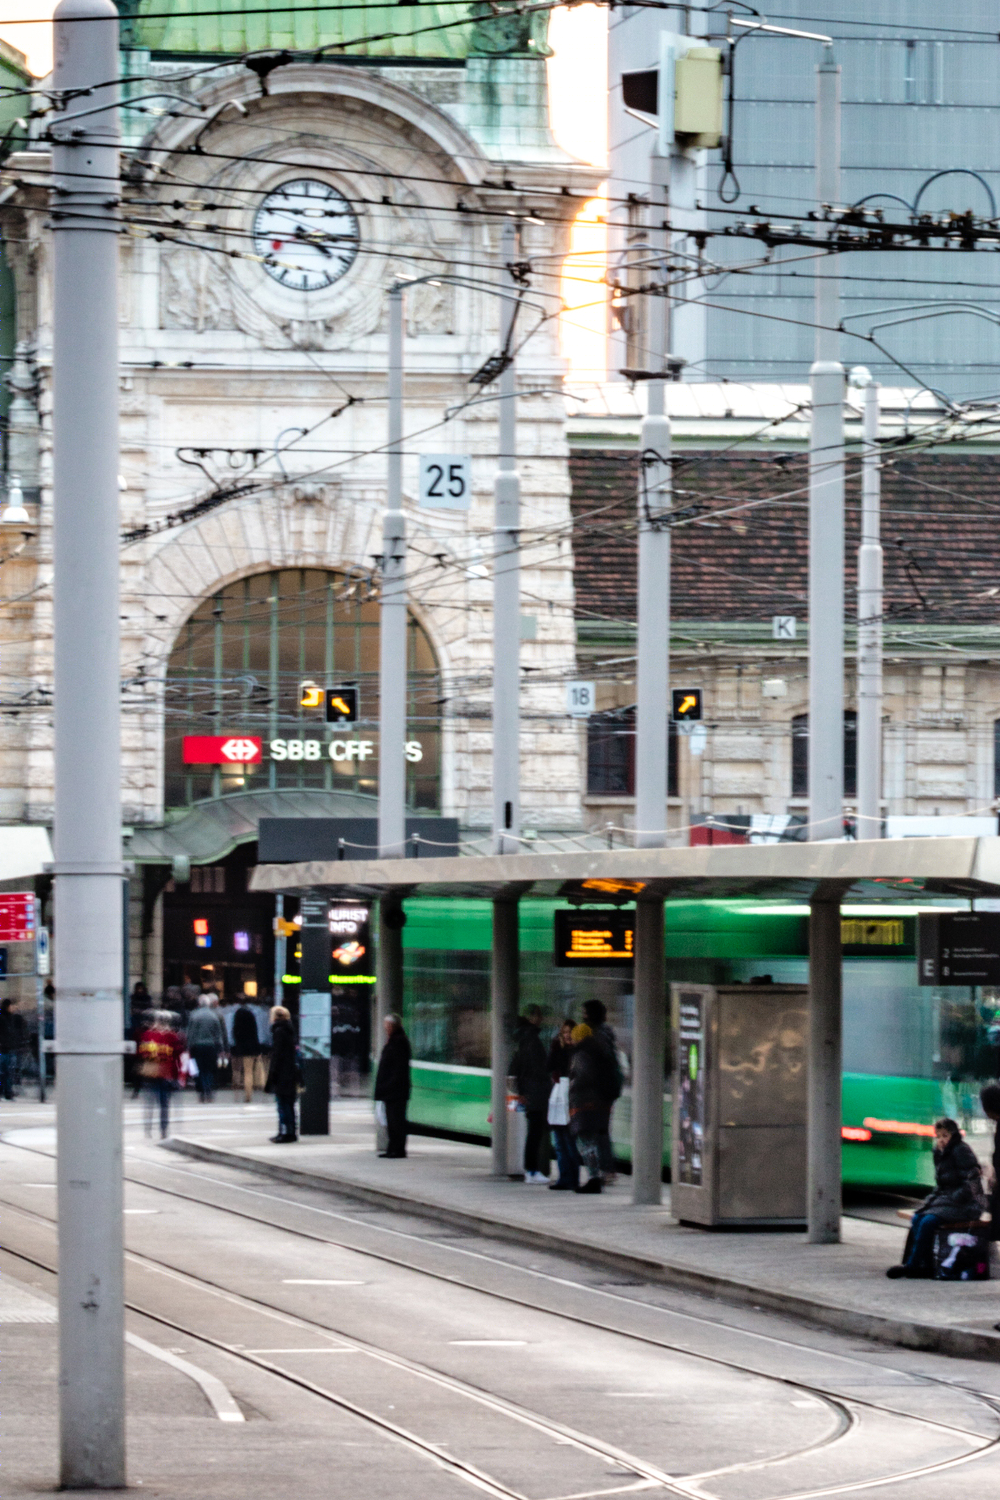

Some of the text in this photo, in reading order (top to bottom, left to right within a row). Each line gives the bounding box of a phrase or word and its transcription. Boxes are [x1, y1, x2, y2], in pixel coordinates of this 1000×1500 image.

[426, 464, 465, 497] 25
[778, 618, 792, 636] K
[571, 688, 590, 705] 18
[270, 739, 322, 761] SBB
[328, 740, 373, 761] CFF
[329, 908, 368, 922] URIST
[330, 921, 357, 933] NFO
[924, 959, 935, 976] E
